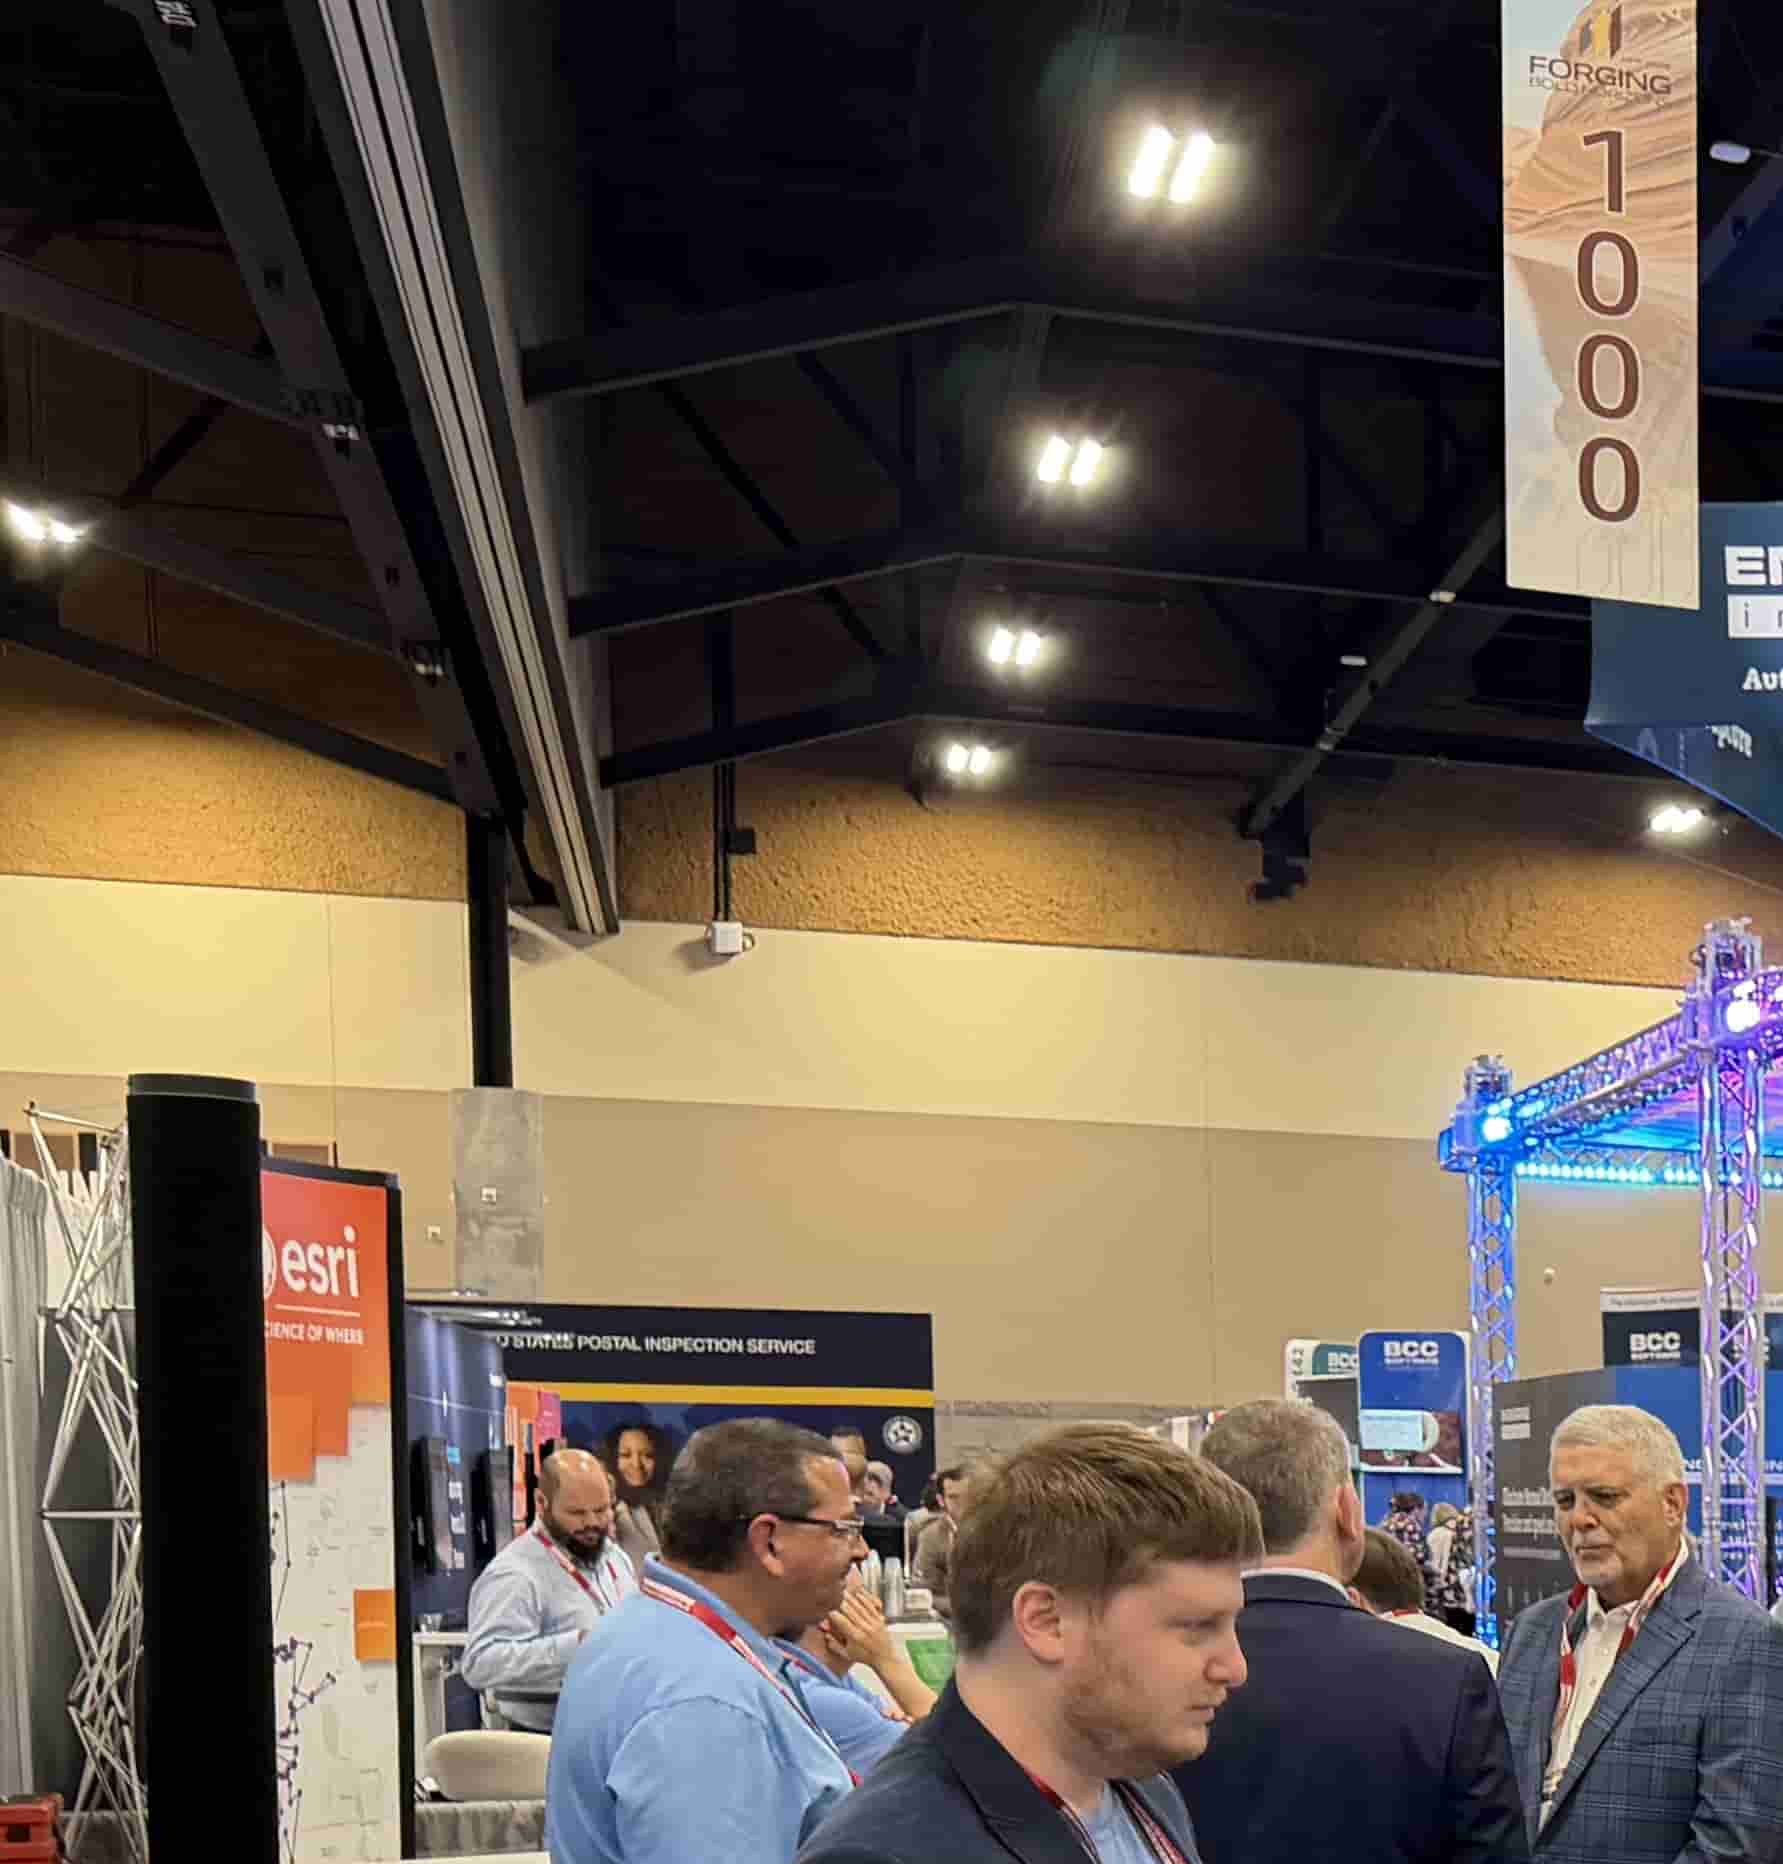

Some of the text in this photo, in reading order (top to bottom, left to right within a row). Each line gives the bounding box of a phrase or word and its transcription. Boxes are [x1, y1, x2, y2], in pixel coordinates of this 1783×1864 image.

[1528, 54, 1672, 96] FORGING
[1575, 128, 1642, 522] 1000
[281, 1224, 360, 1298] esri
[307, 1323, 321, 1342] OF
[325, 1326, 364, 1345] WHERE
[577, 1334, 641, 1351] POSTAL
[645, 1335, 744, 1353] INSPECTION
[746, 1337, 817, 1355] SERVICE
[1630, 1331, 1681, 1352] BCC
[1383, 1340, 1440, 1358] BCC
